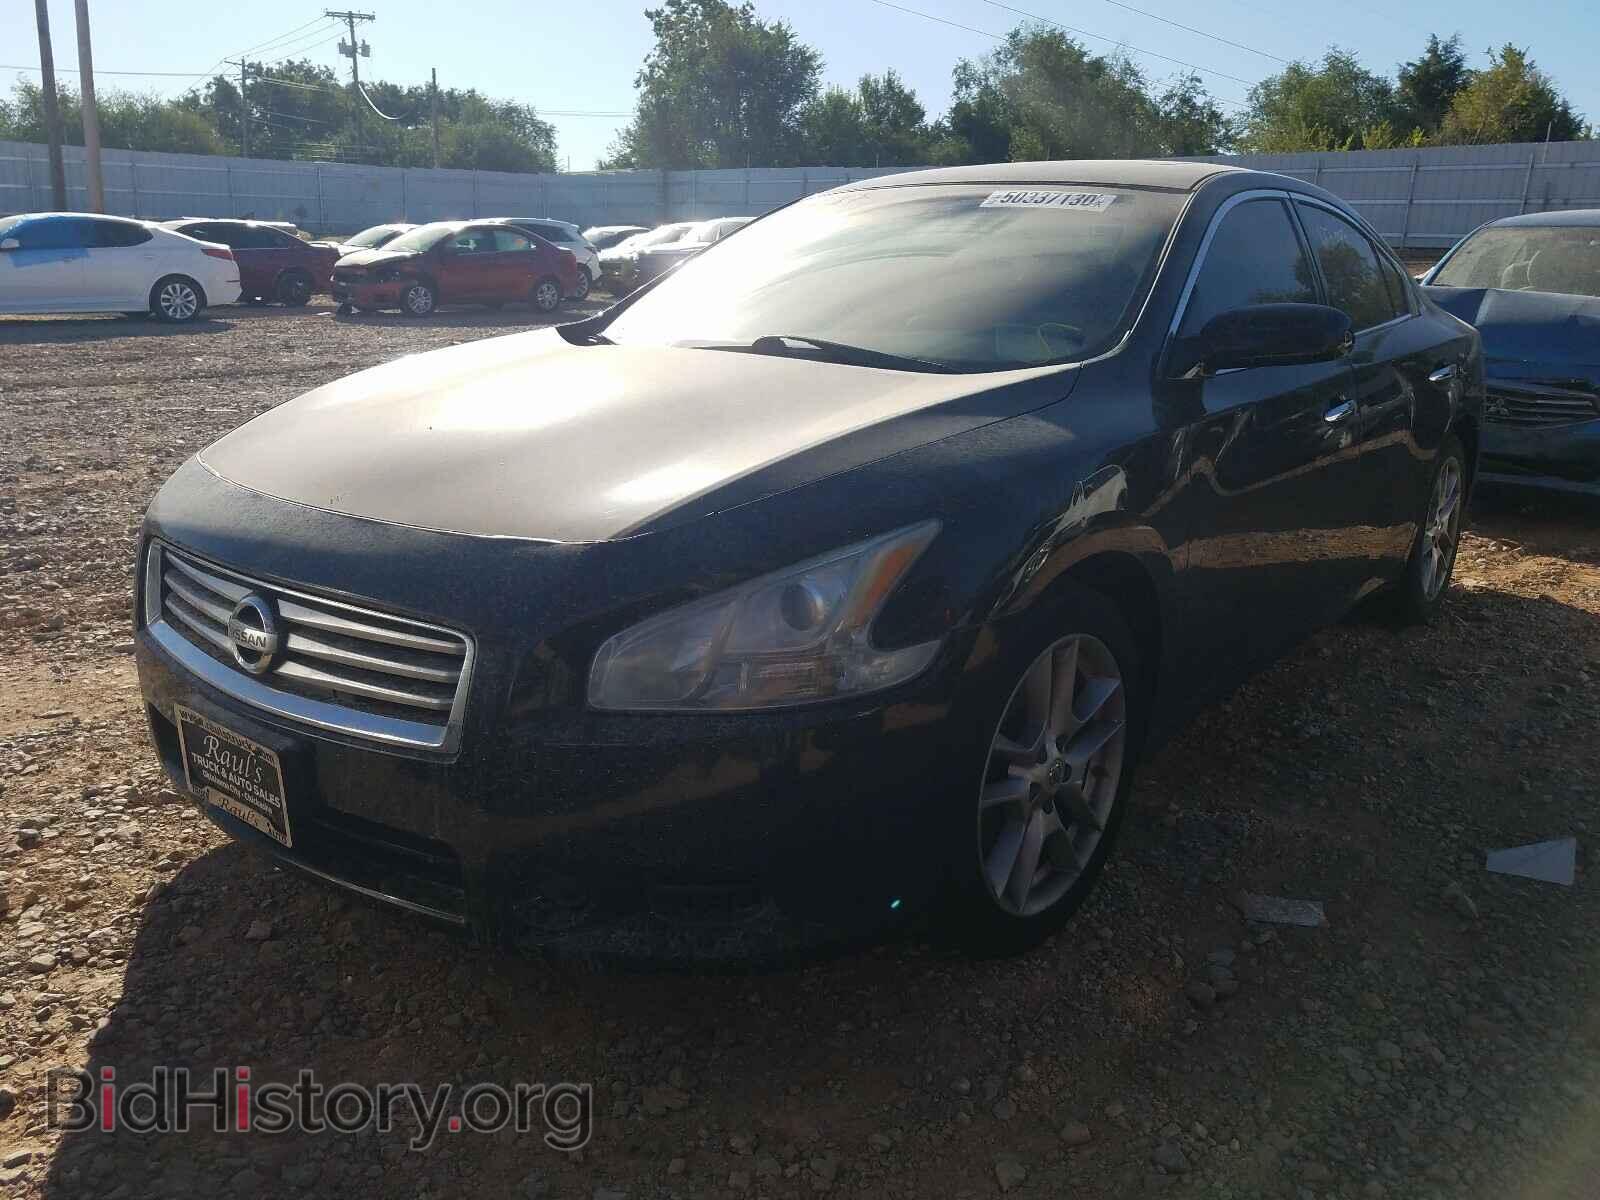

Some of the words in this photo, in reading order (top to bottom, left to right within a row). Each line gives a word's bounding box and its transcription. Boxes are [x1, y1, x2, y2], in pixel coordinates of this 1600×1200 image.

[191, 752, 220, 775] TRUCK
[221, 767, 228, 779] &
[228, 773, 253, 792] AUTO
[253, 784, 281, 809] SALES
[203, 735, 263, 784] Raul's
